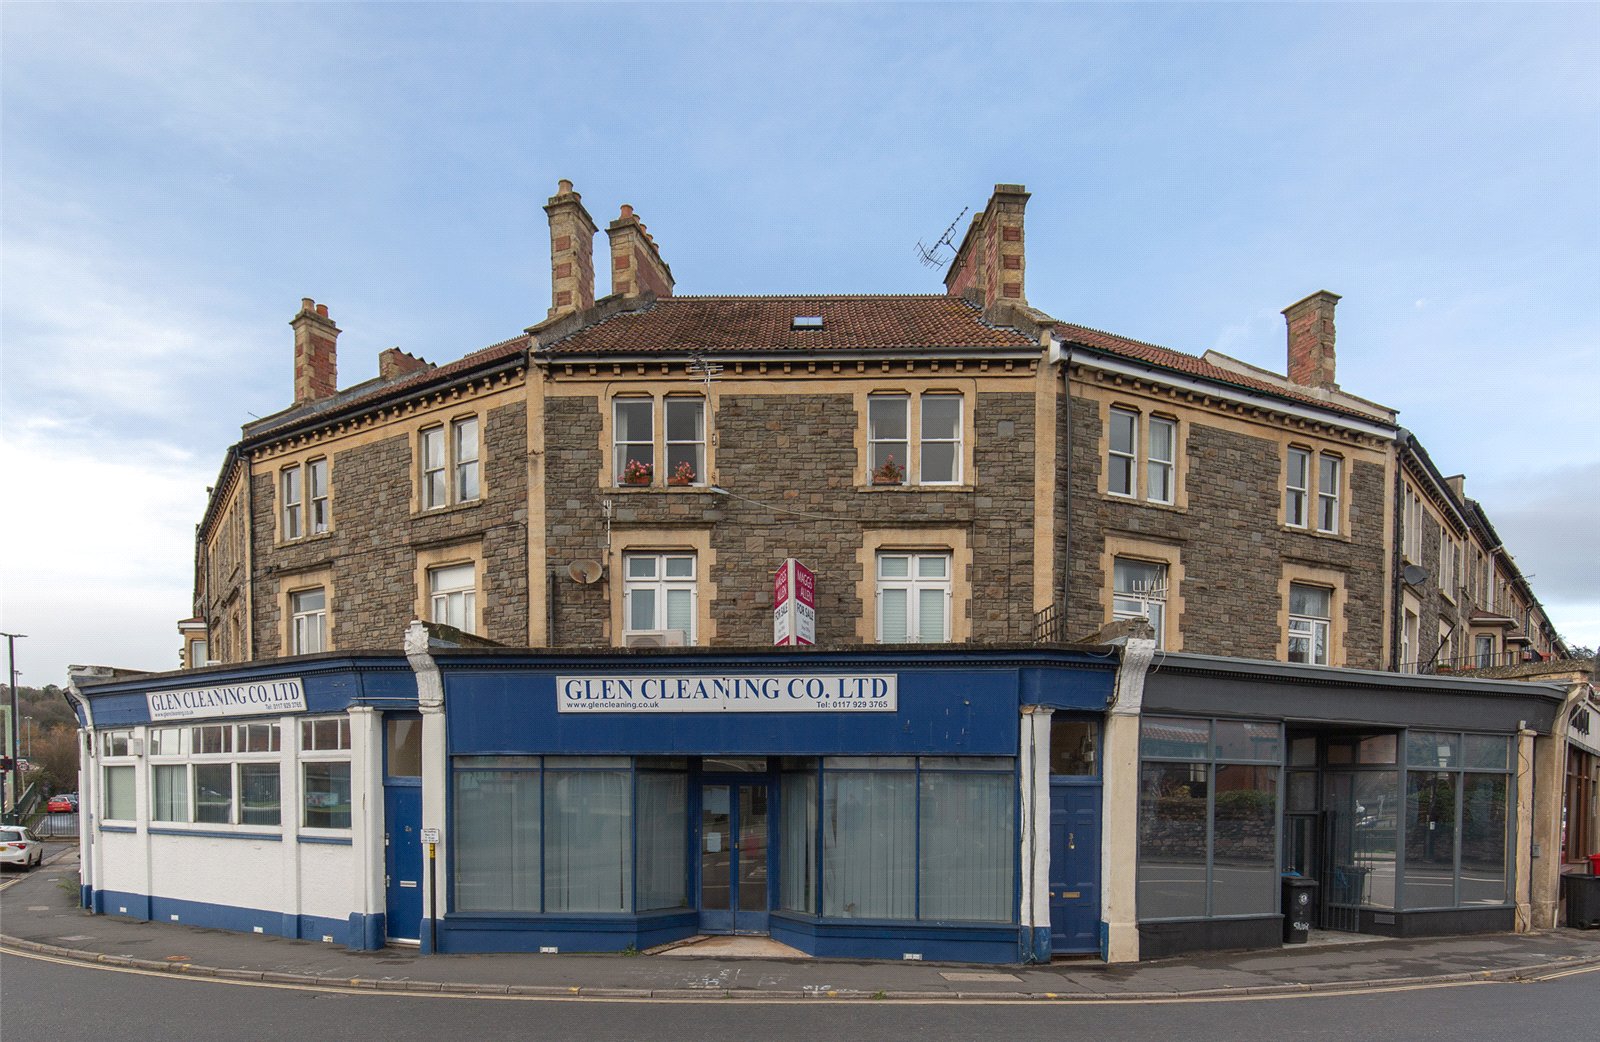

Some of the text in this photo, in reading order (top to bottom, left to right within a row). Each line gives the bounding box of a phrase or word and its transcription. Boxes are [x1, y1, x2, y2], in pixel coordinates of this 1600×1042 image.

[151, 681, 300, 711] GLEN CLEANING CO. LTD
[564, 678, 888, 700] GLEN CLEANING CO. LTD
[566, 701, 660, 710] www.glencleaning.co.uk
[816, 700, 888, 709] Tel: 0117 929 3765
